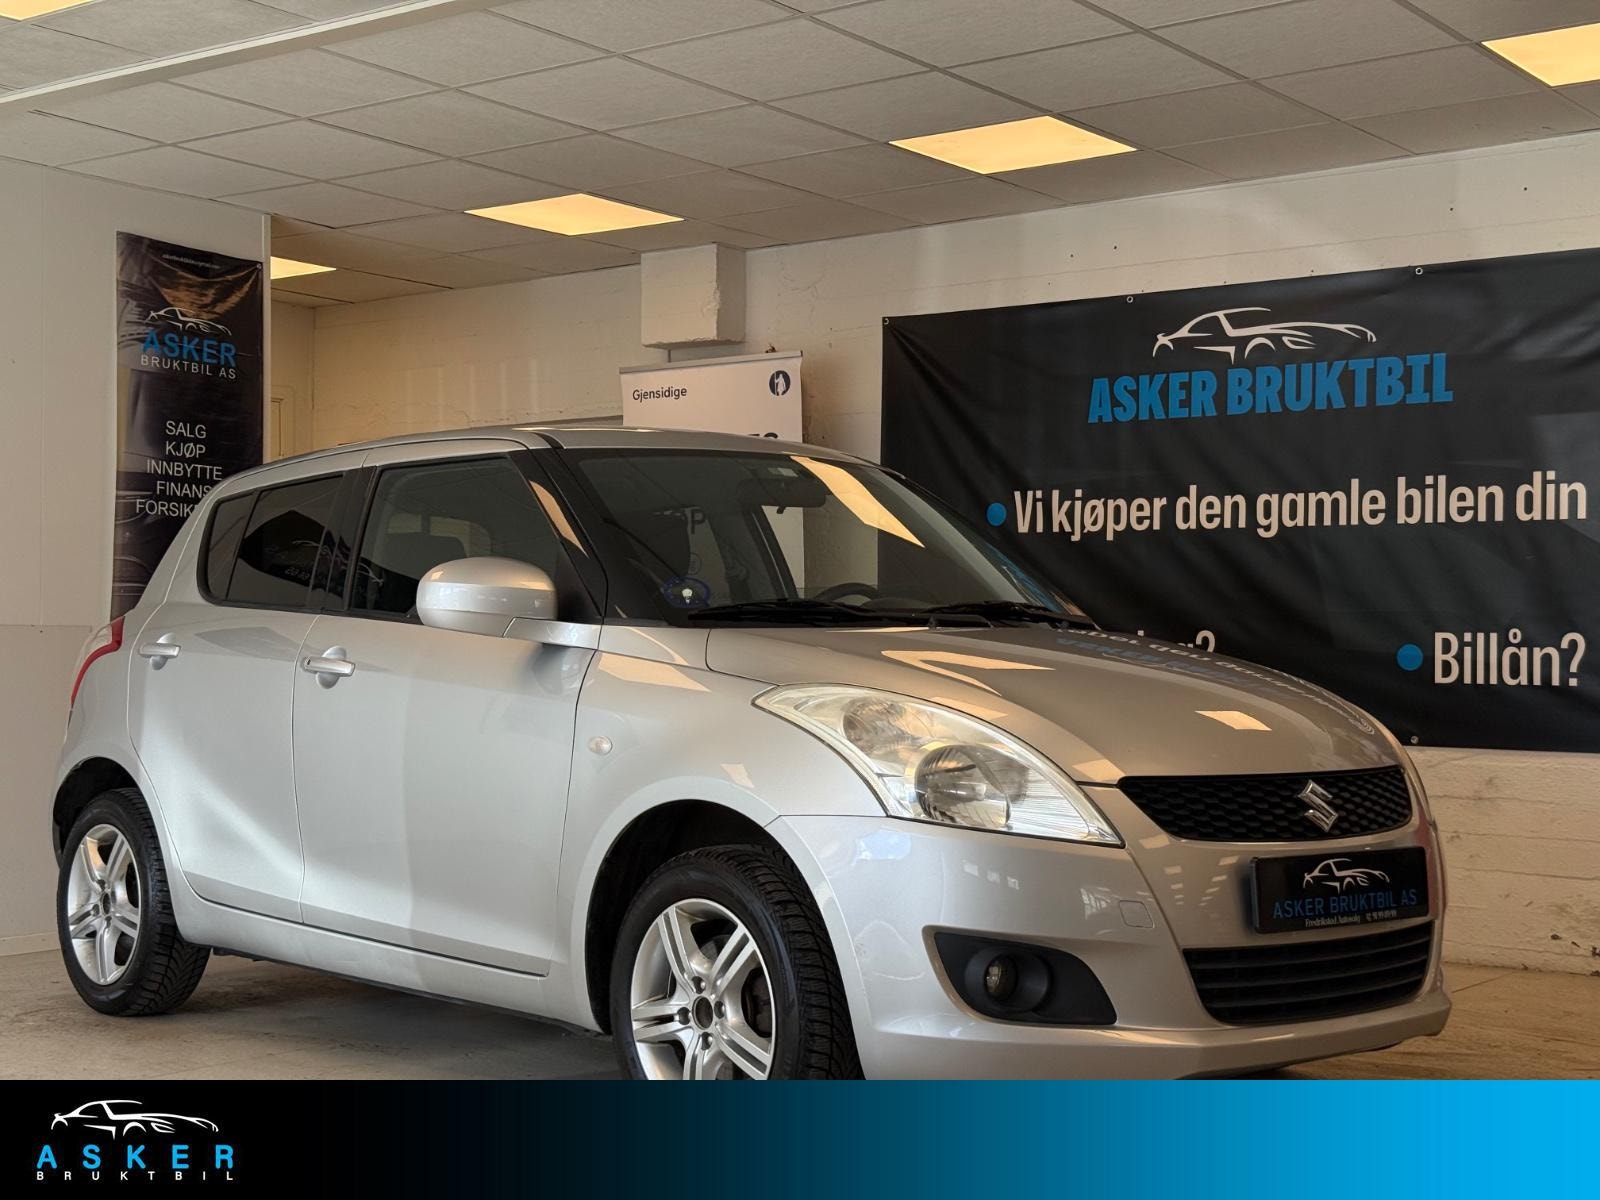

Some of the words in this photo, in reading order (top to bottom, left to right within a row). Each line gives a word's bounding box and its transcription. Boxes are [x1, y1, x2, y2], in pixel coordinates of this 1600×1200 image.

[142, 328, 237, 368] ASKER
[140, 355, 212, 376] BRUKTBIL
[219, 367, 237, 380] AS
[632, 386, 688, 402] Gjensidige
[1088, 370, 1217, 423] ASKER
[1227, 353, 1454, 416] BRUKTBIL
[165, 420, 207, 438] SALG
[165, 440, 206, 458] KJØP
[147, 459, 222, 481] INNBYTTE
[136, 499, 197, 518] FORSIK
[1014, 490, 1043, 533] Vi
[1051, 488, 1167, 542] kjøper
[1175, 485, 1246, 530] den
[1256, 478, 1386, 539] gamle
[1397, 475, 1504, 524] bilen
[1515, 470, 1587, 521] din
[1433, 628, 1587, 687] Billån?
[1273, 898, 1324, 919] ASKER
[1330, 890, 1397, 914] BRUKTBIL
[1401, 888, 1417, 906] AS
